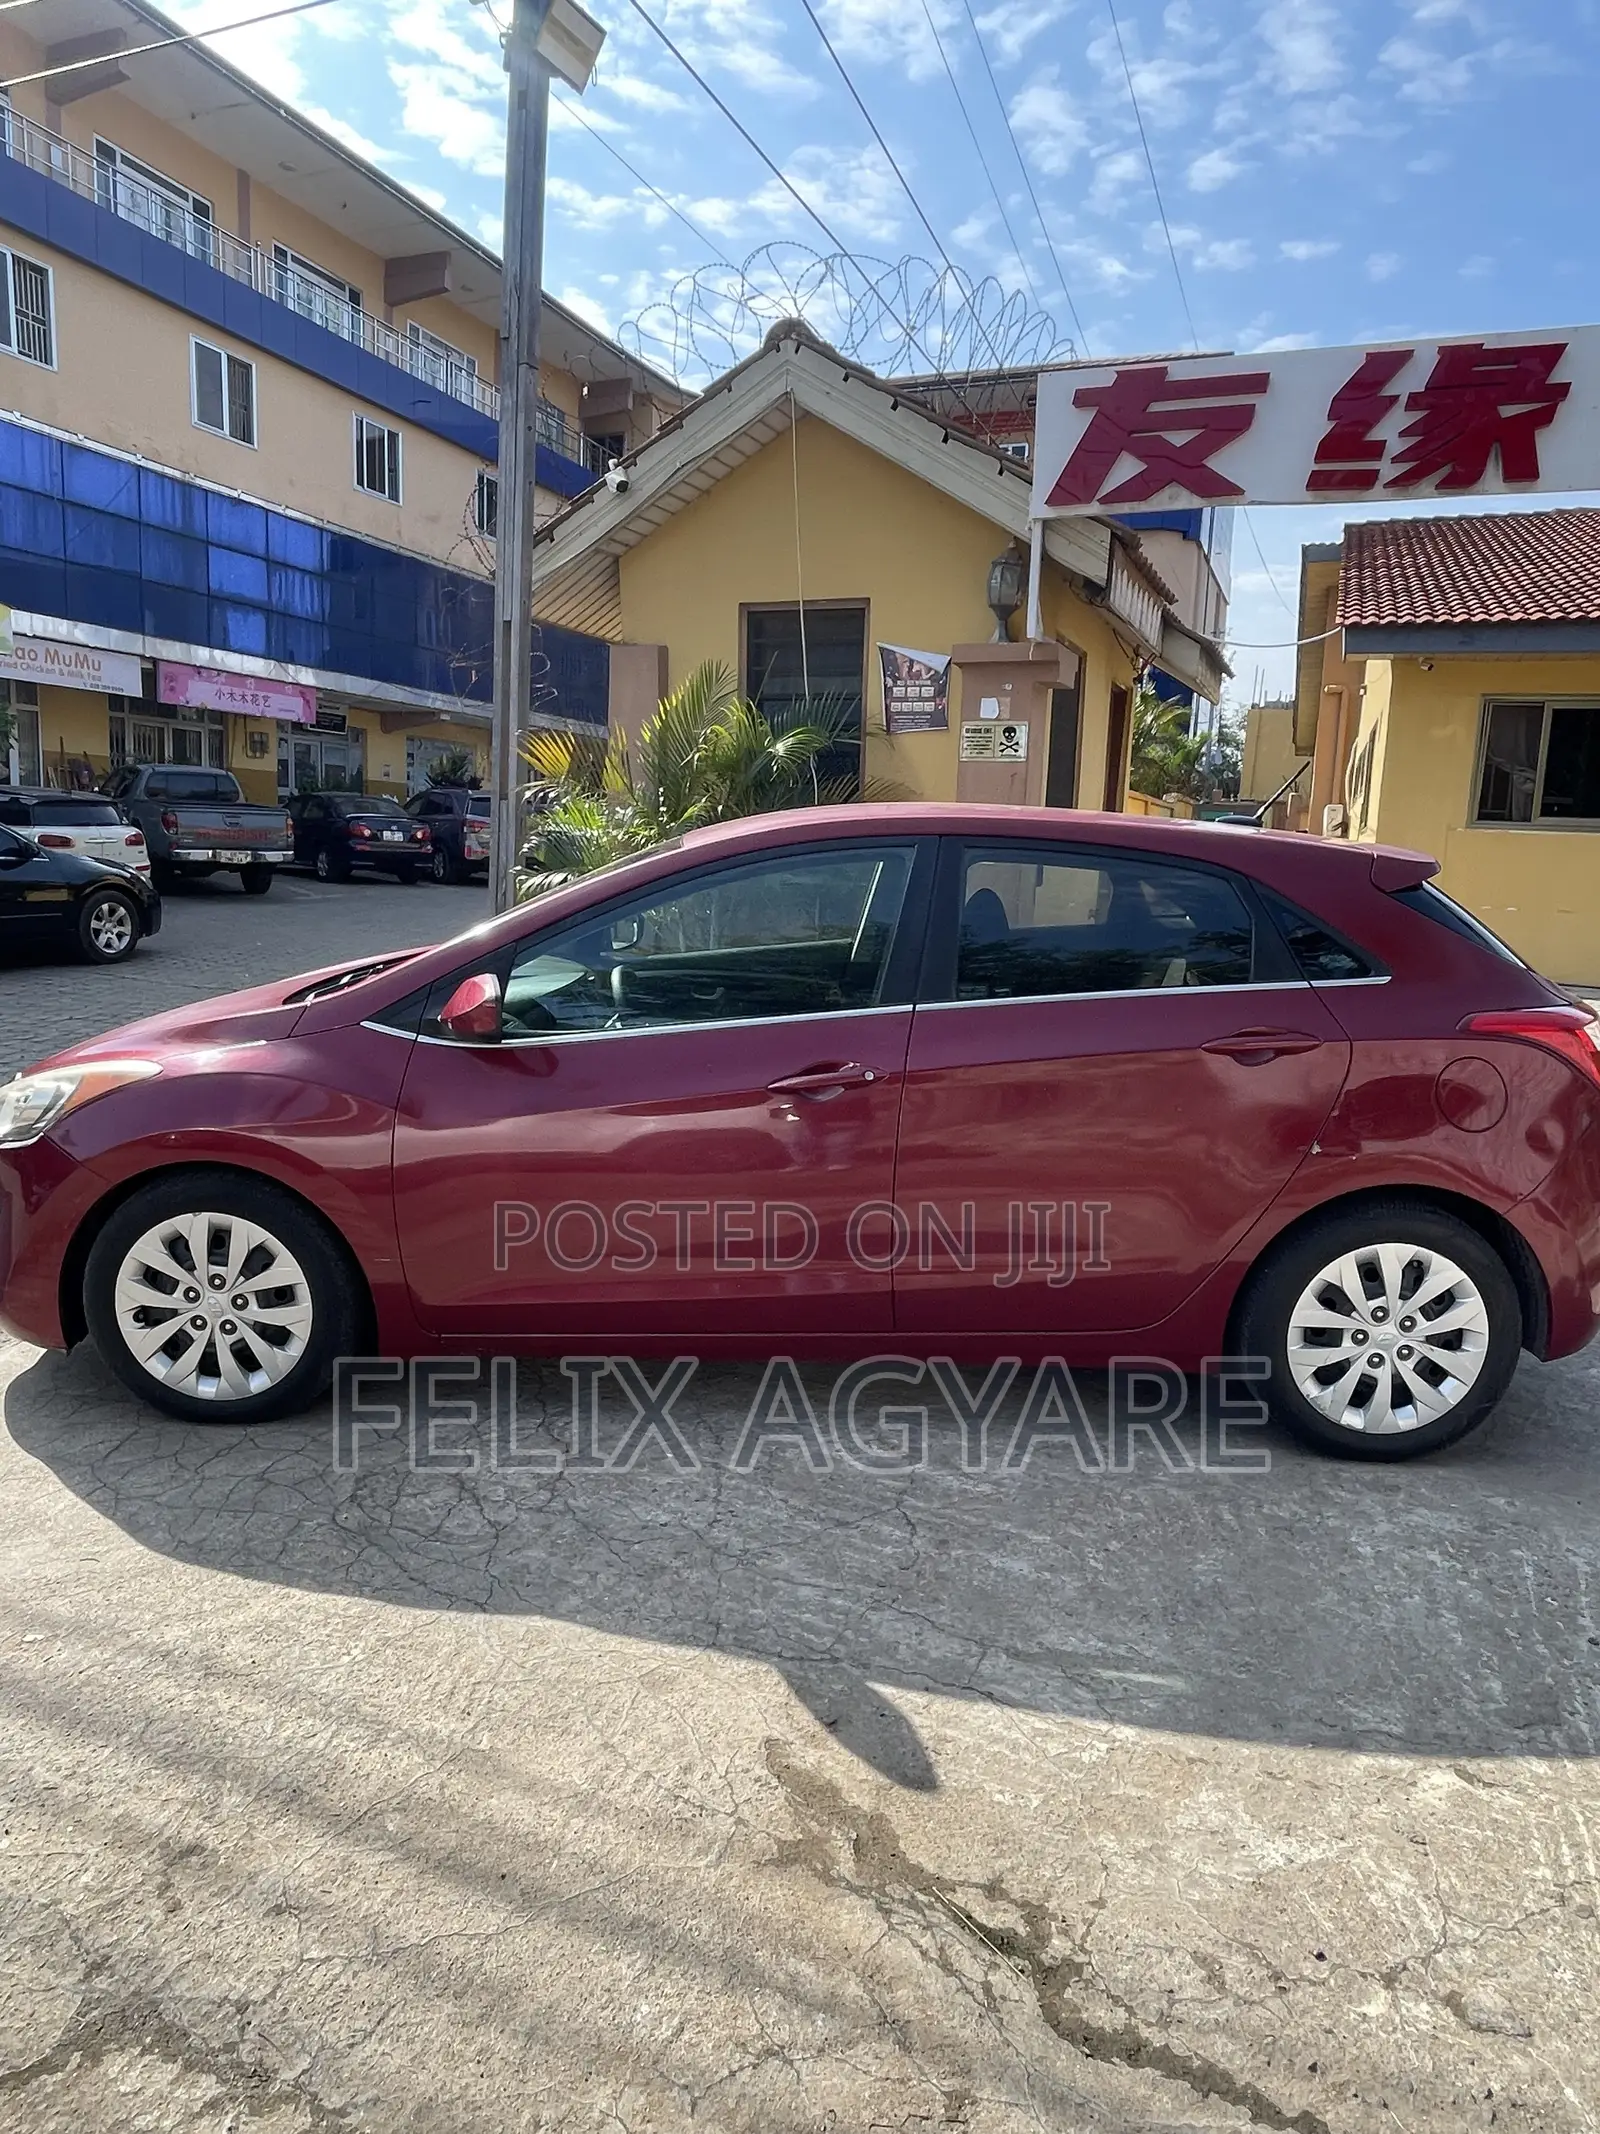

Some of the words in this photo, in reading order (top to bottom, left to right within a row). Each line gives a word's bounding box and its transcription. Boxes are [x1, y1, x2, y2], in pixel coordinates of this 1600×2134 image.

[1046, 343, 1571, 506] 友缘
[13, 646, 38, 662] ao
[44, 647, 101, 672] MuMu
[214, 688, 272, 708] 小木木花艺
